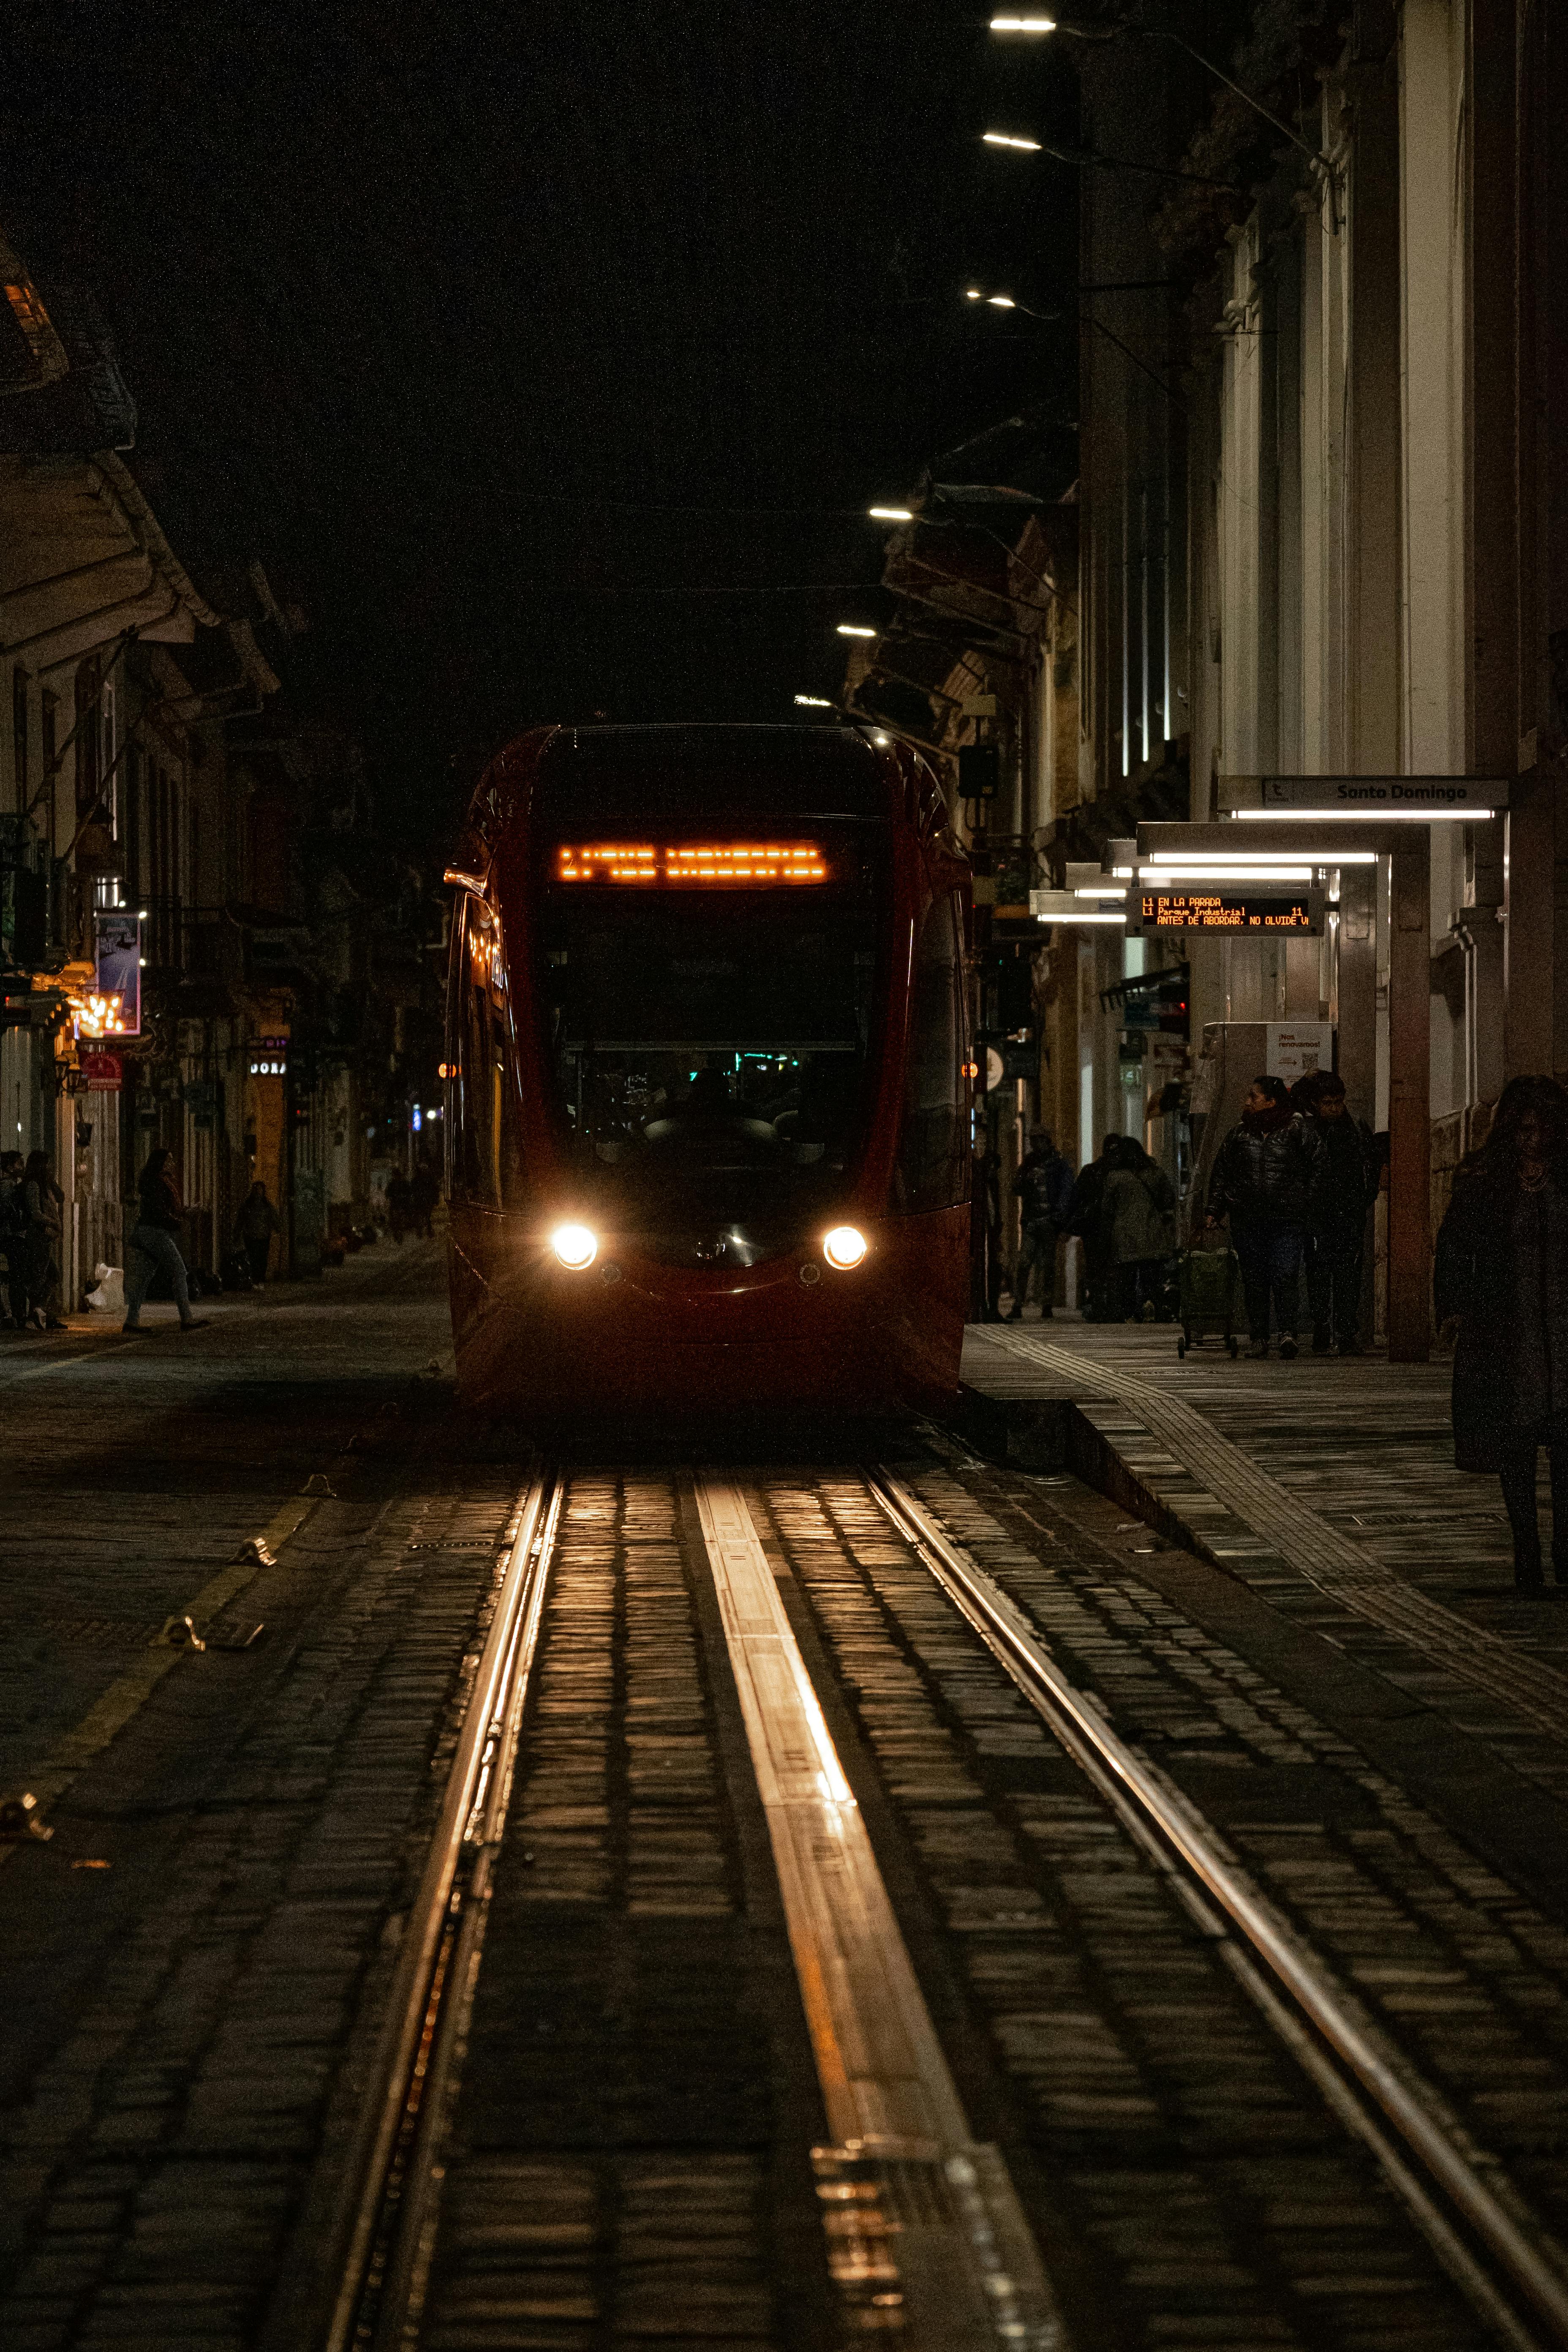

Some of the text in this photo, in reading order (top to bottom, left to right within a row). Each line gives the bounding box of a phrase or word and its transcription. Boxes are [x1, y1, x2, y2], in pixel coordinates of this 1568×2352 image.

[1337, 784, 1467, 802] Santo Domingo
[1143, 897, 1221, 906] L1 EN LA PARADA
[1142, 906, 1303, 916] L1 Parque Industrial 11
[1157, 916, 1184, 925] ANTES
[1188, 916, 1199, 925] DE
[1203, 916, 1244, 926] ABORDAR,
[1250, 916, 1260, 925] NO
[1265, 916, 1296, 925] OLVIDE
